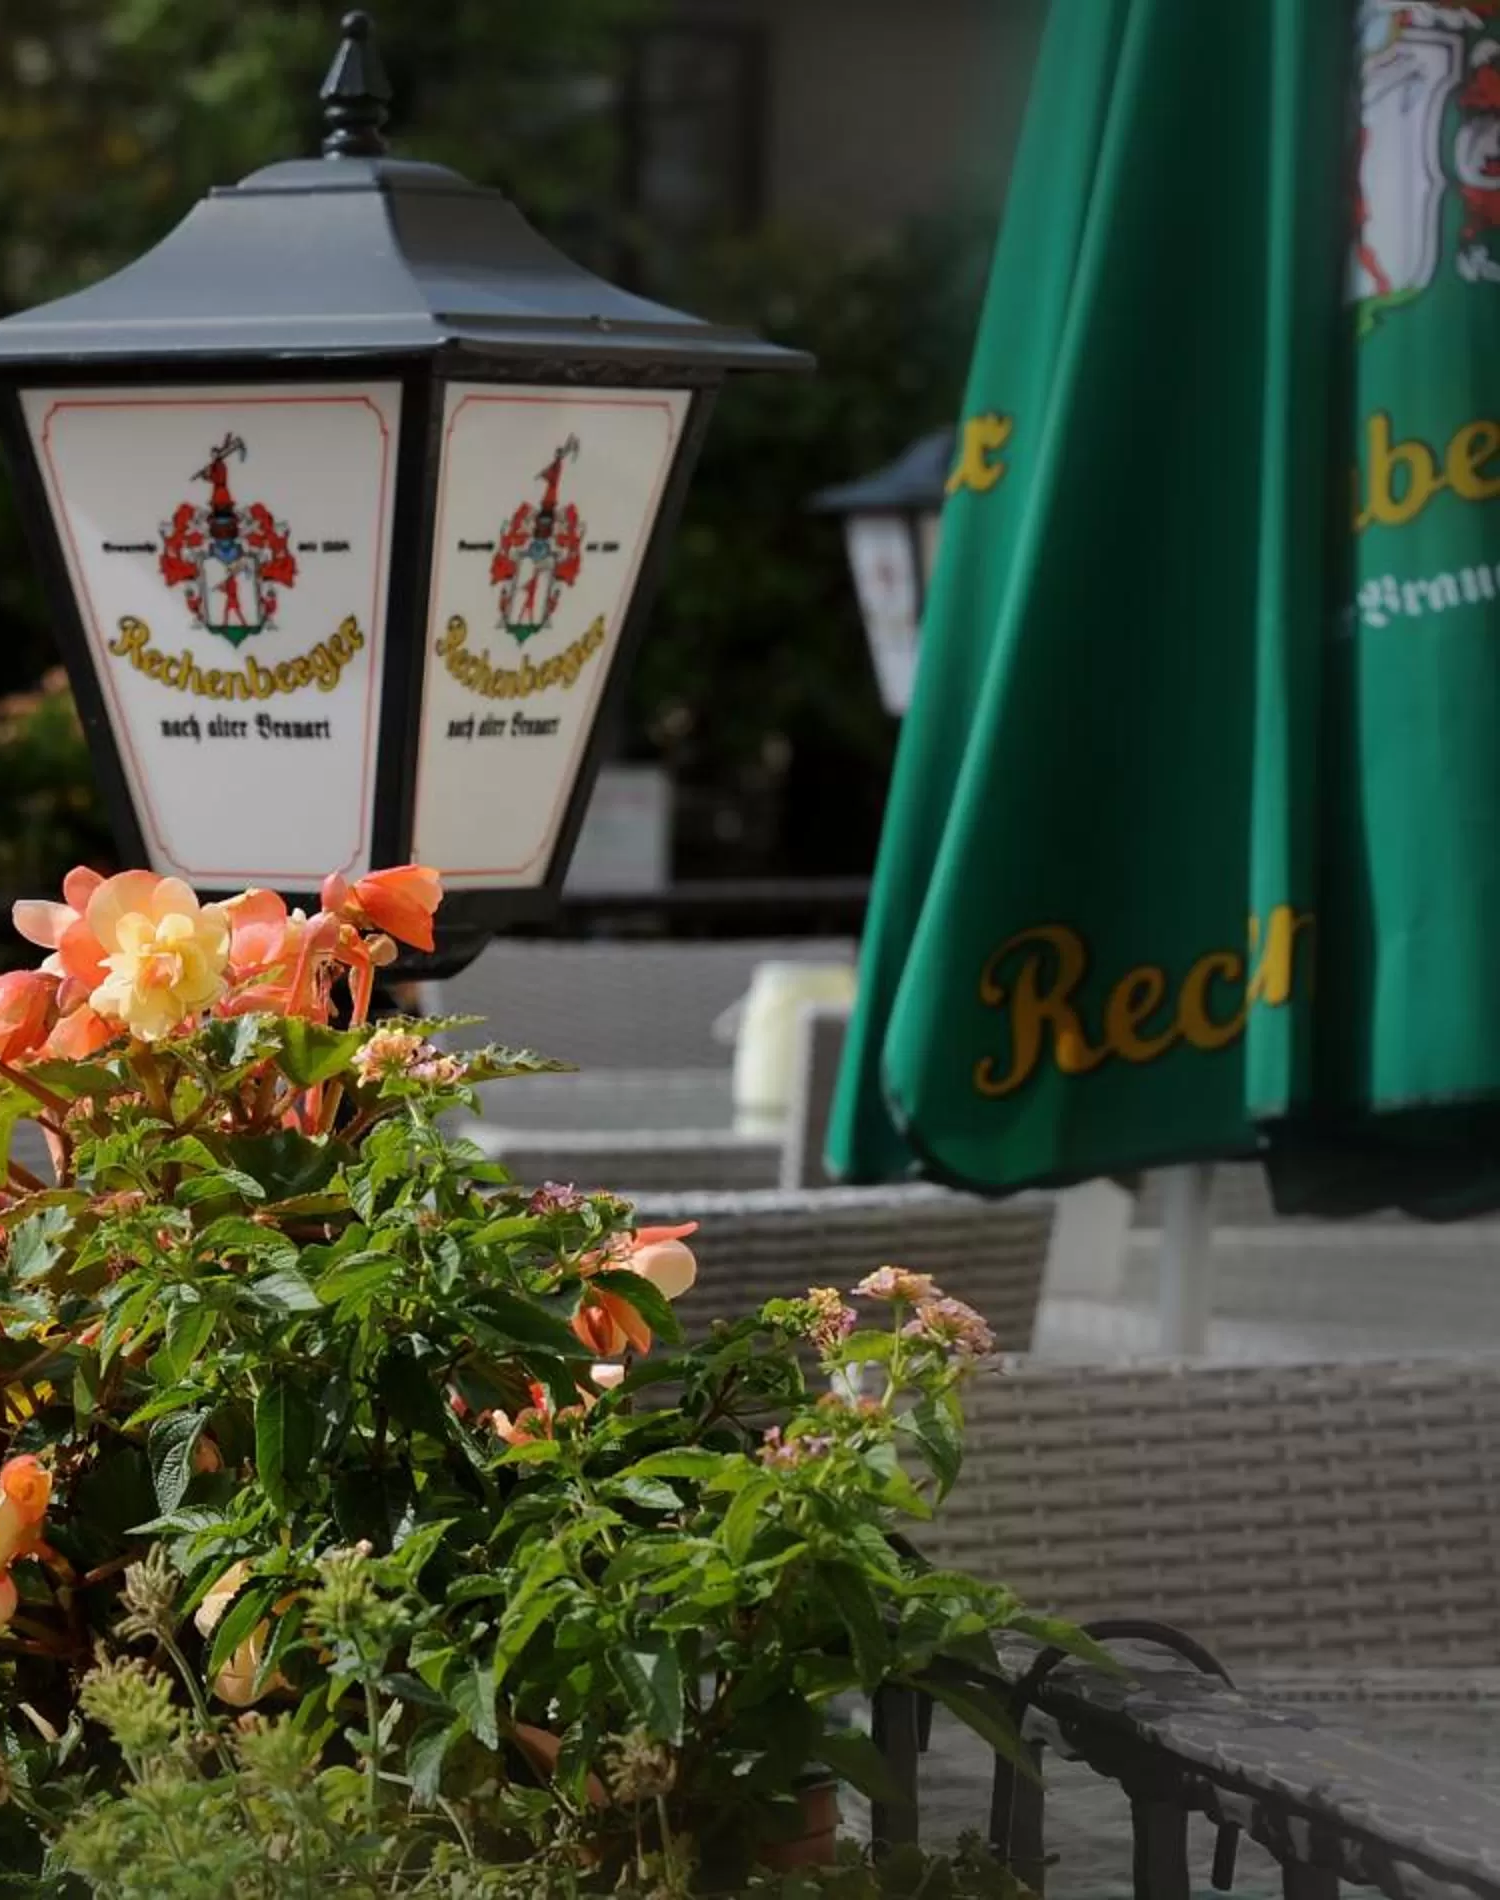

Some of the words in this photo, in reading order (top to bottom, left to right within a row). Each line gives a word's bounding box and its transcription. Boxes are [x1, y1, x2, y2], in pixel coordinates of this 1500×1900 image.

[1356, 565, 1500, 628] Brau
[108, 614, 364, 700] Rechenberger
[161, 714, 201, 743] nach
[207, 713, 248, 737] alter
